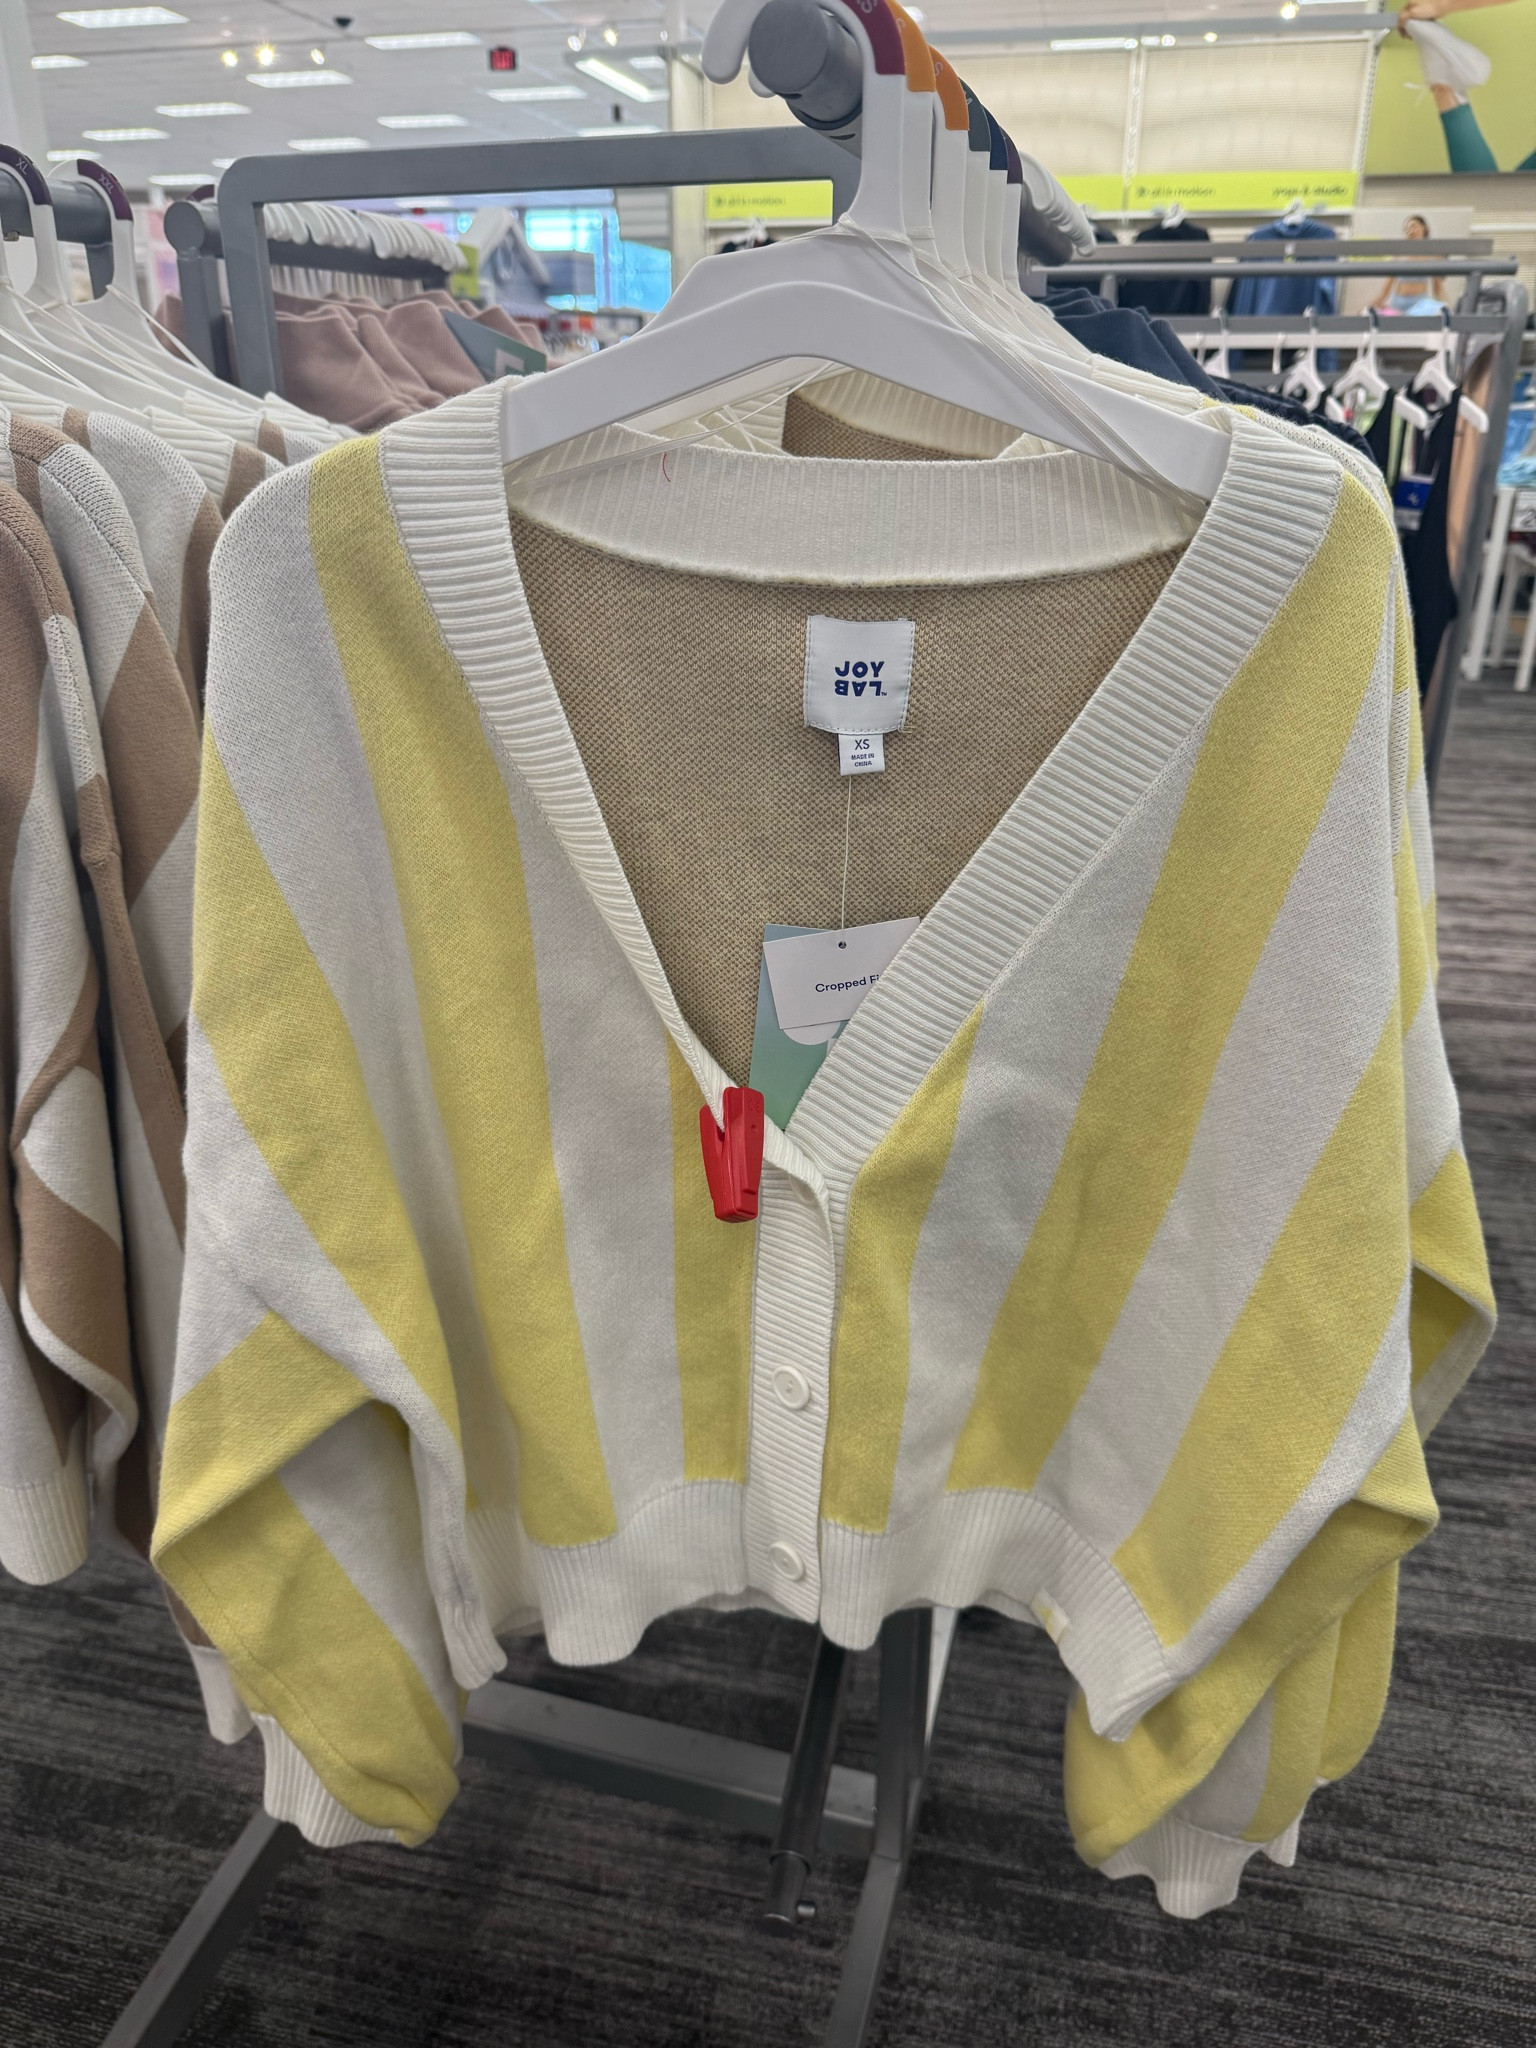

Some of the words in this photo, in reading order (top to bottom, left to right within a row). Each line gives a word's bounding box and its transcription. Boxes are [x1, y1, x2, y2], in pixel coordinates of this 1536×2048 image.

[16, 157, 28, 175] XL
[99, 173, 115, 195] XXL
[834, 661, 885, 678] JOY
[834, 679, 882, 697] LAB
[854, 738, 870, 751] XS
[851, 753, 868, 761] MADE
[854, 760, 873, 768] CHINA
[815, 976, 867, 994] Cropped
[869, 974, 882, 985] Fi
